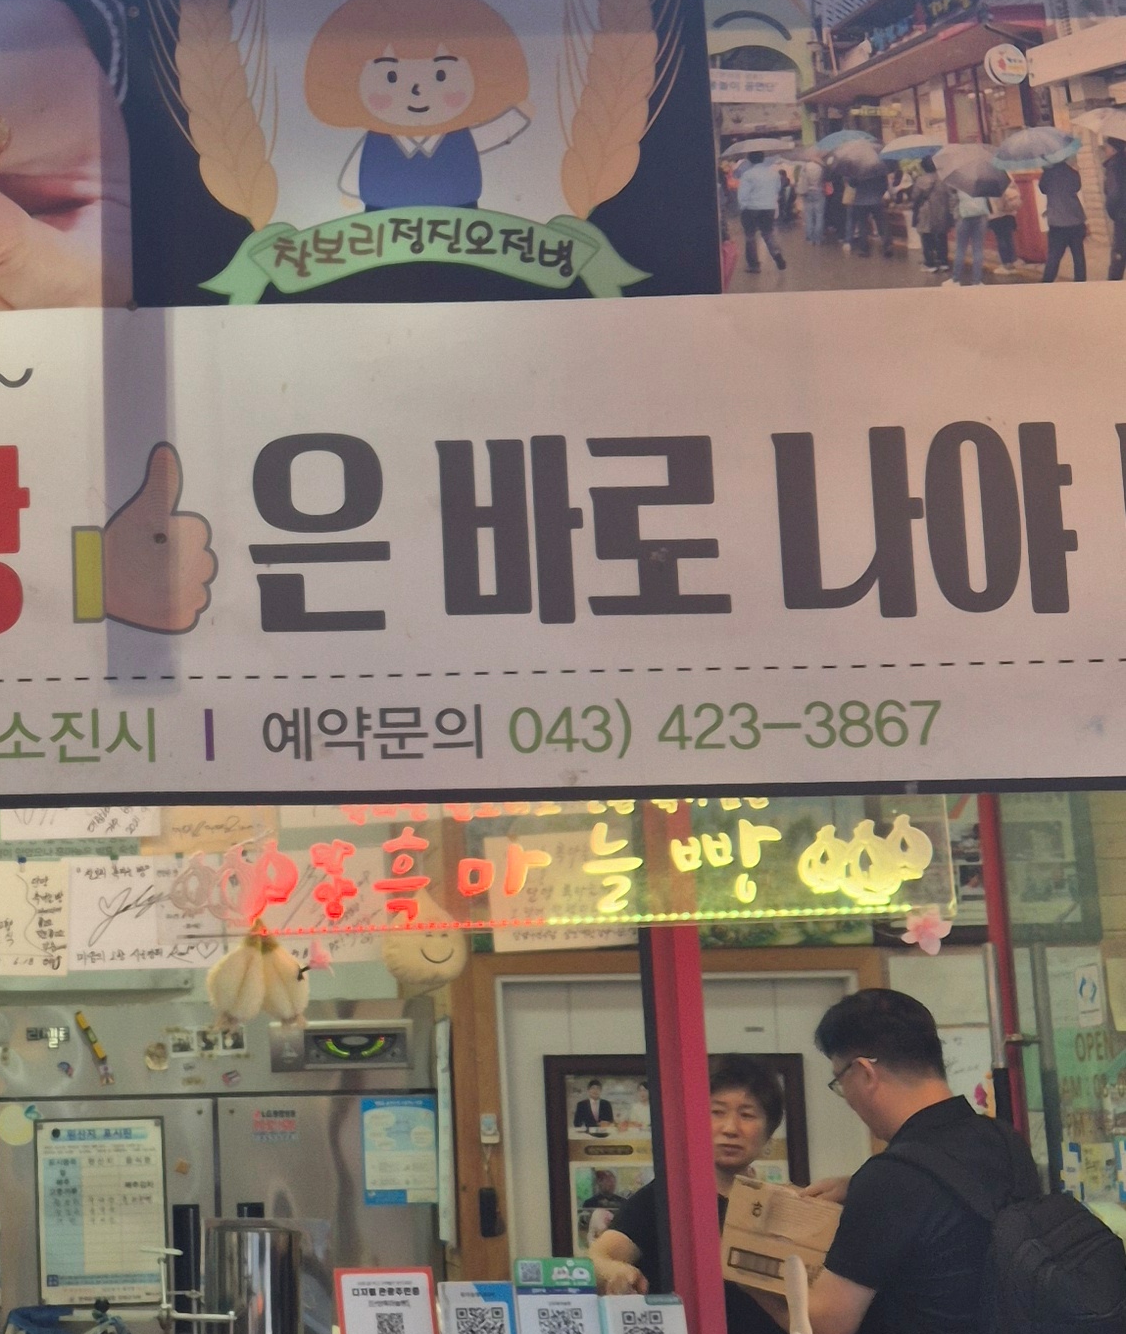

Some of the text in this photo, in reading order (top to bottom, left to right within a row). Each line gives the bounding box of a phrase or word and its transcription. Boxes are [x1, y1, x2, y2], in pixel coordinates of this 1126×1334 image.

[248, 432, 392, 633] 은
[435, 433, 734, 625] 바로
[771, 420, 1079, 620] 나야
[261, 703, 485, 763] 예약문의
[509, 705, 634, 761] 043)
[658, 698, 943, 754] 423-3867
[67, 1128, 96, 1141] 원산지
